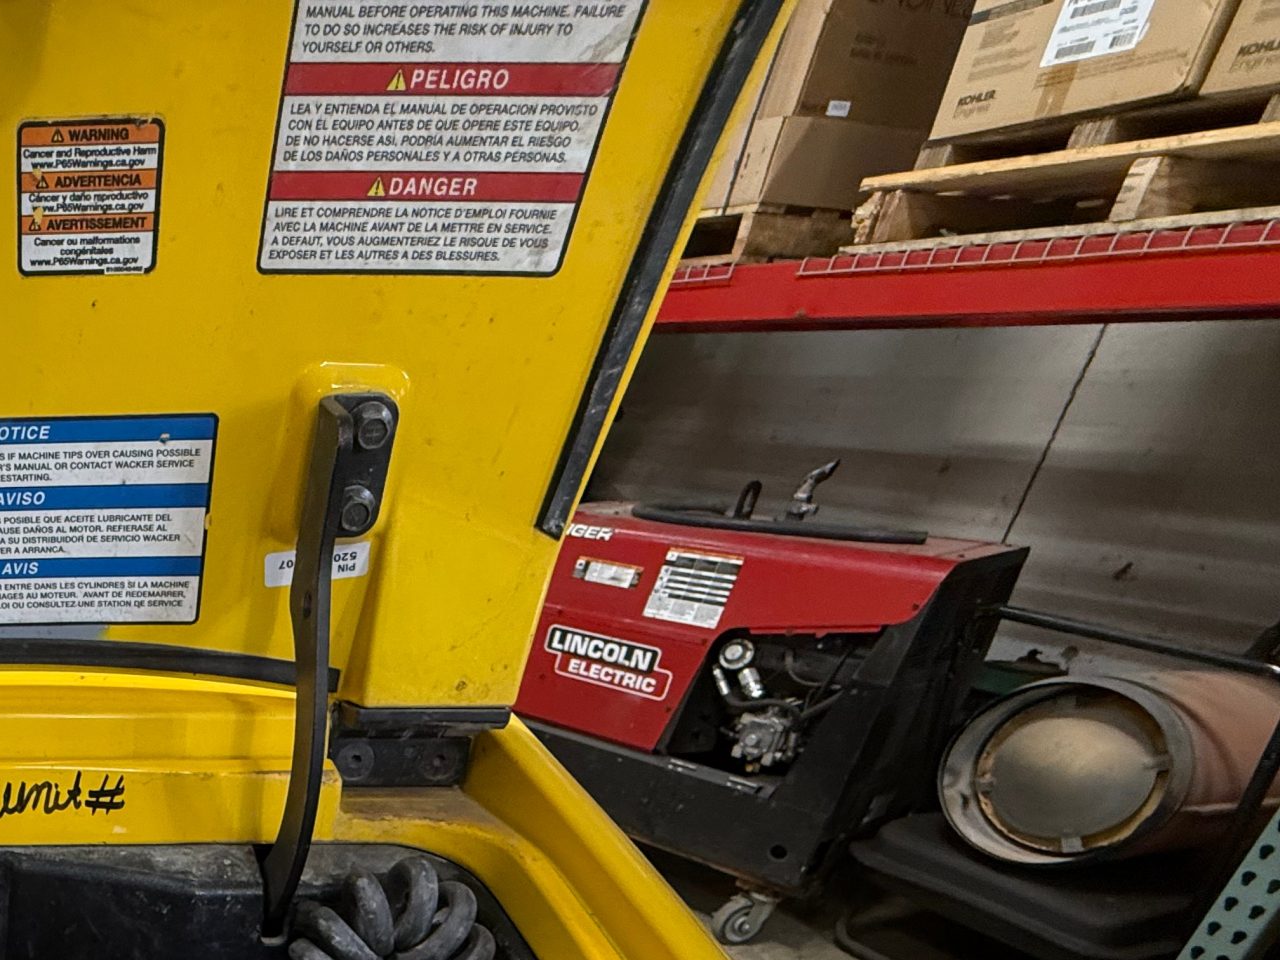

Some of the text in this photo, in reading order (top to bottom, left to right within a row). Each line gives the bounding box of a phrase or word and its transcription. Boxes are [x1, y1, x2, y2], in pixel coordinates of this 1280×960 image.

[305, 7, 626, 17] MANUAL BEFORE OPERATING THIS MACHINE. FAILURE
[302, 24, 574, 36] TO DO SO INCREASES THE RISK OF INJURY TO
[300, 42, 437, 52] YOURSELF OR OTHERS.
[1237, 40, 1280, 57] KOHL
[409, 69, 510, 90] PELIGRO
[957, 89, 996, 106] KOHLER
[289, 104, 312, 114] LEA
[313, 104, 322, 114] Y
[323, 104, 382, 114] ENTIENDA
[381, 104, 398, 114] EL
[398, 104, 449, 114] MANUAL
[449, 104, 468, 114] DE
[467, 104, 539, 115] OPERACION
[286, 120, 313, 130] CON
[314, 120, 330, 130] EL
[330, 120, 375, 131] EQUIPO
[375, 120, 415, 130] ANTES
[414, 120, 433, 130] DE
[432, 120, 460, 132] QUE
[460, 121, 502, 131] OPERE
[501, 121, 534, 131] ESTE
[68, 129, 129, 141] WARNING
[284, 136, 301, 146] DE
[302, 136, 320, 146] NO
[321, 136, 375, 146] HACERSE
[444, 136, 510, 147] AUMENTAR
[509, 137, 527, 147] EL
[525, 137, 572, 147] RIESGO
[23, 146, 156, 158] Cancer and Reproductive Harm
[283, 149, 569, 162] DE LOS DAÑOS PERSONALES Y A OTRAS PERSONAS.
[54, 174, 141, 187] ADVERTENCIA
[389, 177, 478, 197] DANGER
[61, 193, 67, 203] y
[46, 217, 147, 230] AVERTISSEMENT
[33, 237, 65, 245] Cancer
[79, 235, 140, 244] malformations
[7, 454, 16, 462] IF
[17, 452, 60, 462] MACHINE
[63, 452, 83, 460] TIPS
[84, 451, 110, 460] OVER
[111, 449, 153, 459] CAUSING
[155, 448, 200, 457] POSSIBLE
[13, 463, 52, 472] MANUAL
[53, 463, 68, 471] OR
[69, 461, 113, 471] CONTACT
[114, 460, 154, 469] WACKER
[156, 459, 194, 468] SERVICE
[1, 562, 38, 575] AVIS
[337, 563, 356, 573] PIN
[551, 629, 655, 671] LINCOLN
[567, 657, 657, 693] ELECTRIC
